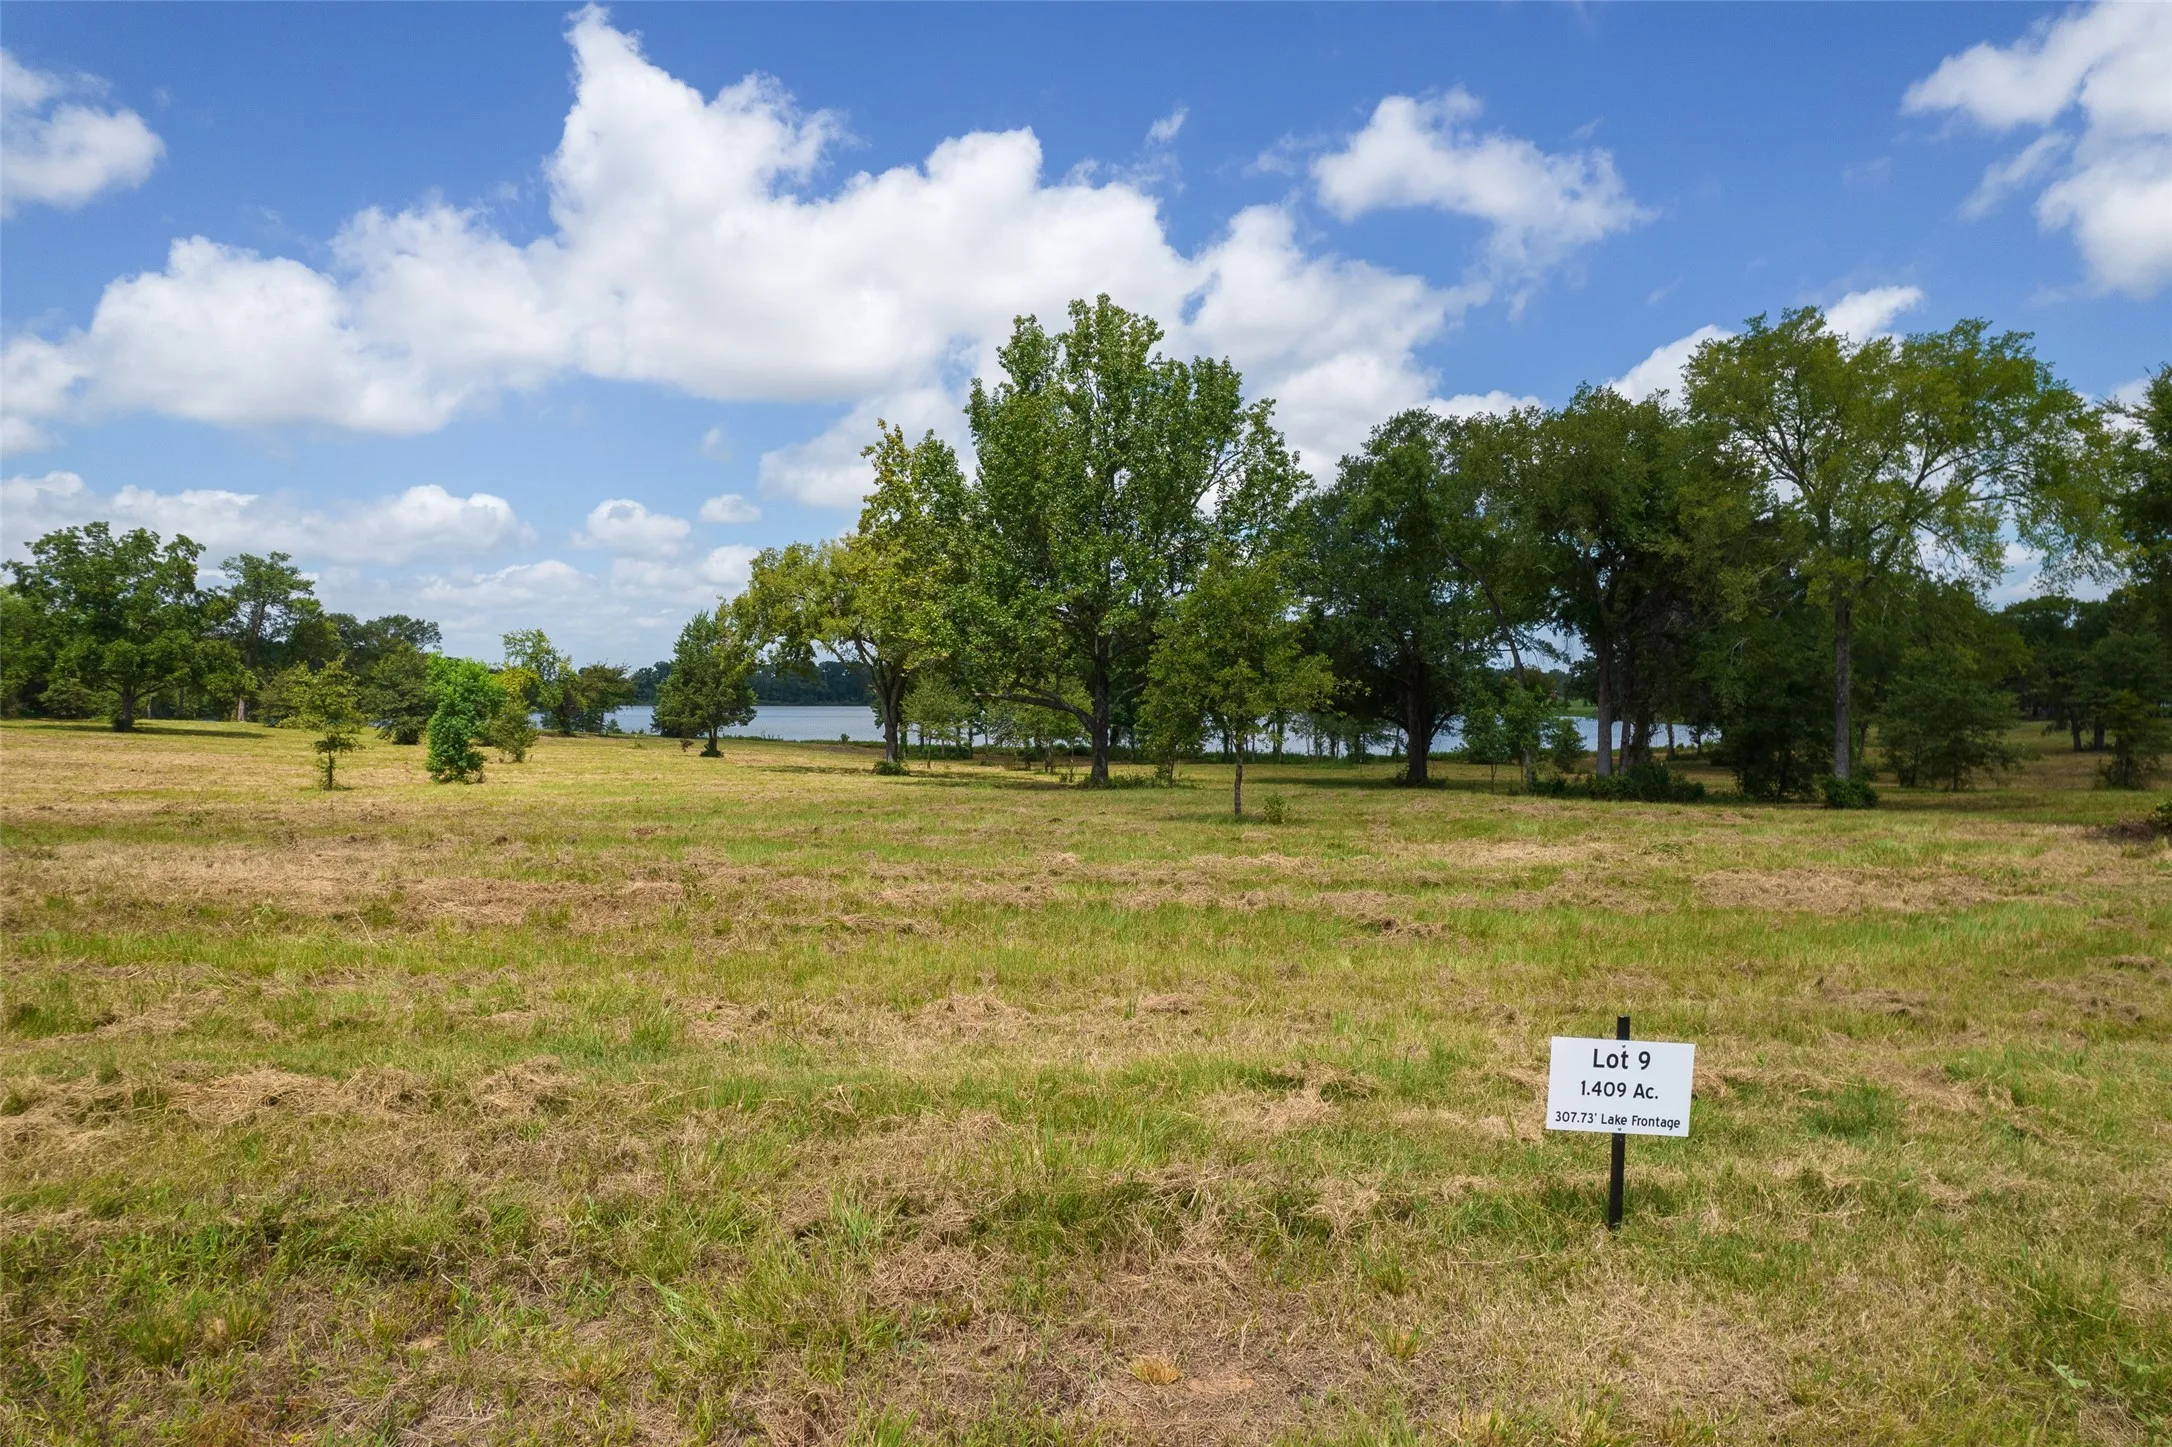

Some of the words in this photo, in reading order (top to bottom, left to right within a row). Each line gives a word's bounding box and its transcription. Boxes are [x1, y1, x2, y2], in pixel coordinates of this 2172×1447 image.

[1592, 1049, 1629, 1070] Lot
[1639, 1050, 1651, 1071] 9
[1580, 1079, 1627, 1098] 1.409
[1632, 1083, 1659, 1100] Ac.
[1555, 1110, 1598, 1124] 307.73'
[1600, 1113, 1628, 1127] Lake
[1631, 1114, 1681, 1131] Frontage
